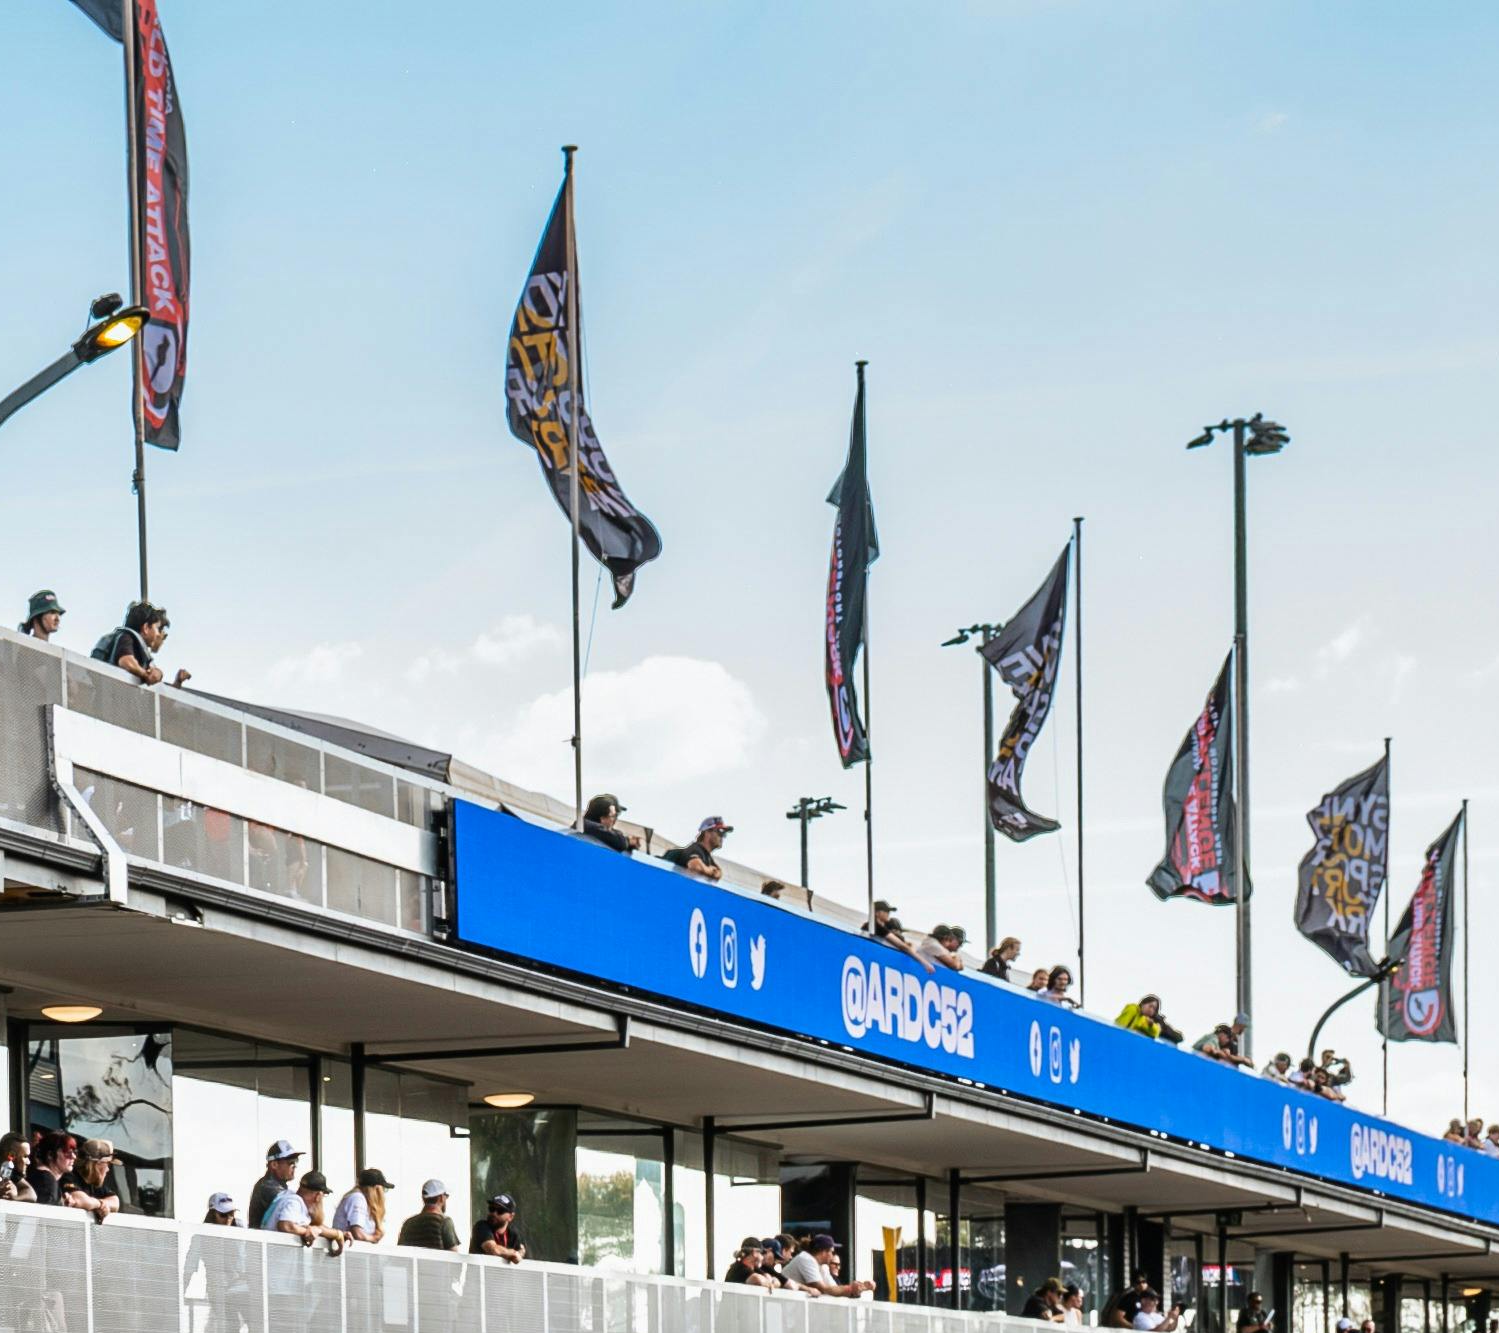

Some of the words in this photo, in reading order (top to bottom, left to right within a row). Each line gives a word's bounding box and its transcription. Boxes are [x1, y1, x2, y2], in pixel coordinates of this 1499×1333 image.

[146, 88, 166, 174] TIME
[146, 177, 174, 312] ATTACK
[841, 954, 976, 1061] @ARDC52
[1350, 1121, 1413, 1185] @ARDC52
